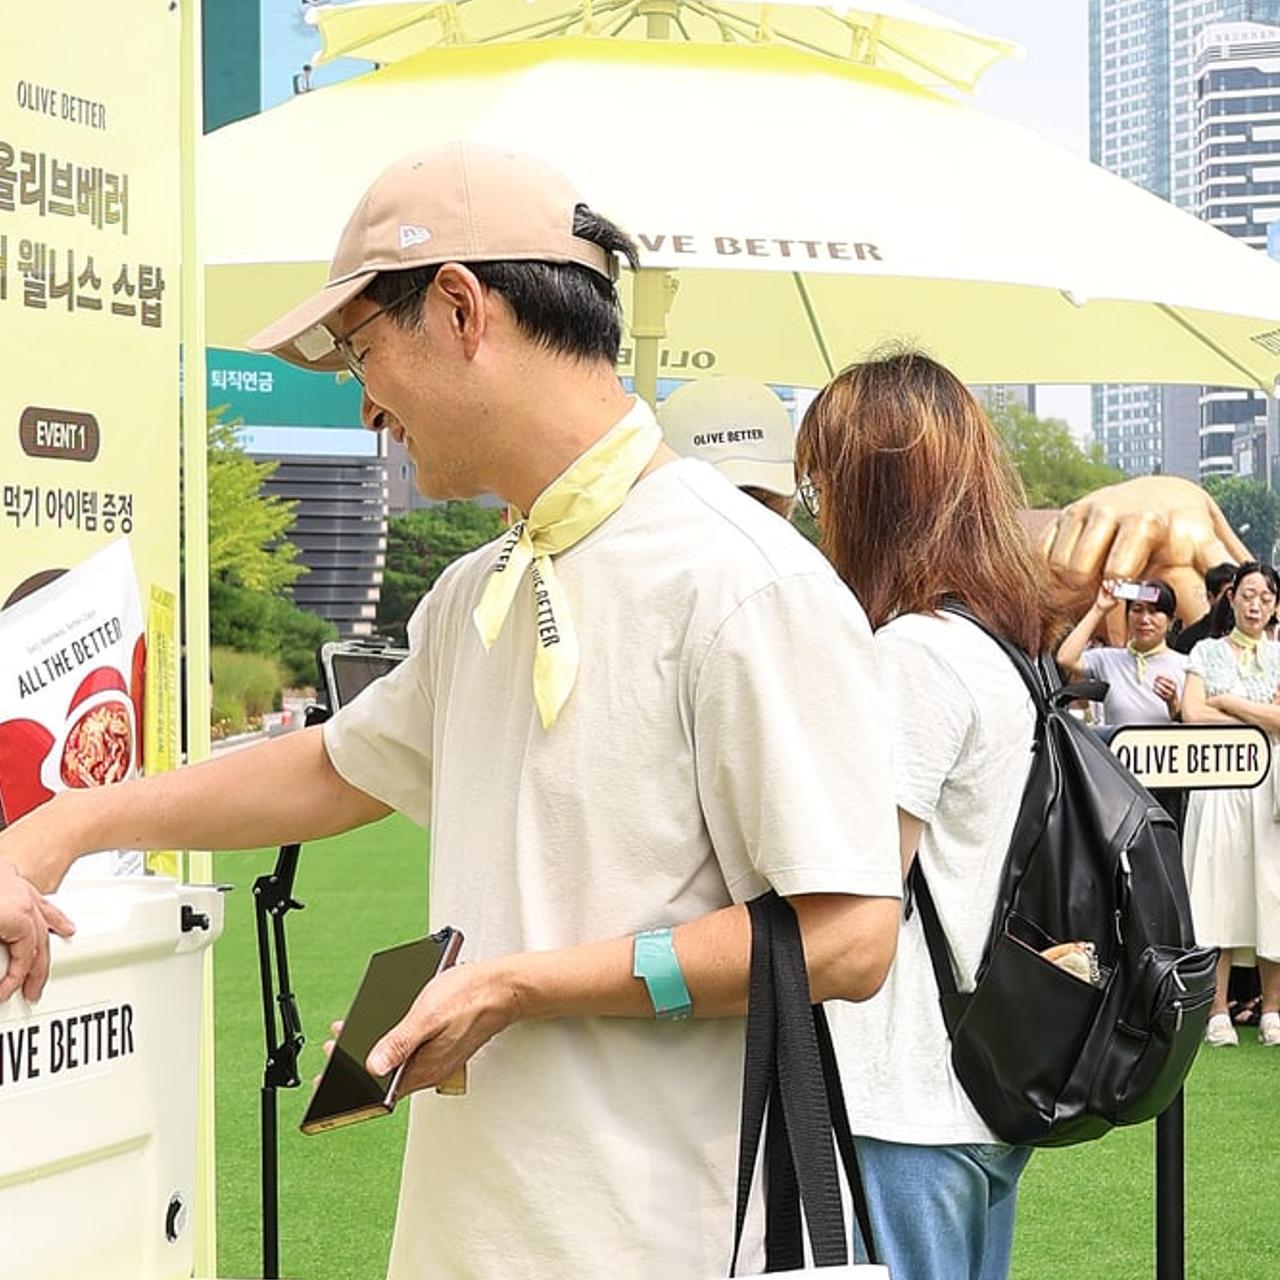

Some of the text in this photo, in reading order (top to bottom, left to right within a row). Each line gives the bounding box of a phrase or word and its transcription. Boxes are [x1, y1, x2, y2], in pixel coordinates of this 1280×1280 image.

[17, 80, 106, 131] OLIVE BETTER
[715, 236, 884, 261] BETTER
[17, 239, 102, 312] 웰니스
[111, 264, 165, 328] 스탑
[211, 370, 274, 392] 퇴직연금
[694, 428, 764, 446] OLIVE BETTER
[4, 484, 39, 528] 먹기
[46, 488, 98, 532] 아이템
[102, 494, 134, 534] 증정
[17, 666, 48, 699] ALL
[41, 647, 75, 681] THE
[1117, 743, 1259, 774] OLIVE BETTER
[50, 1003, 134, 1073] BETTER
